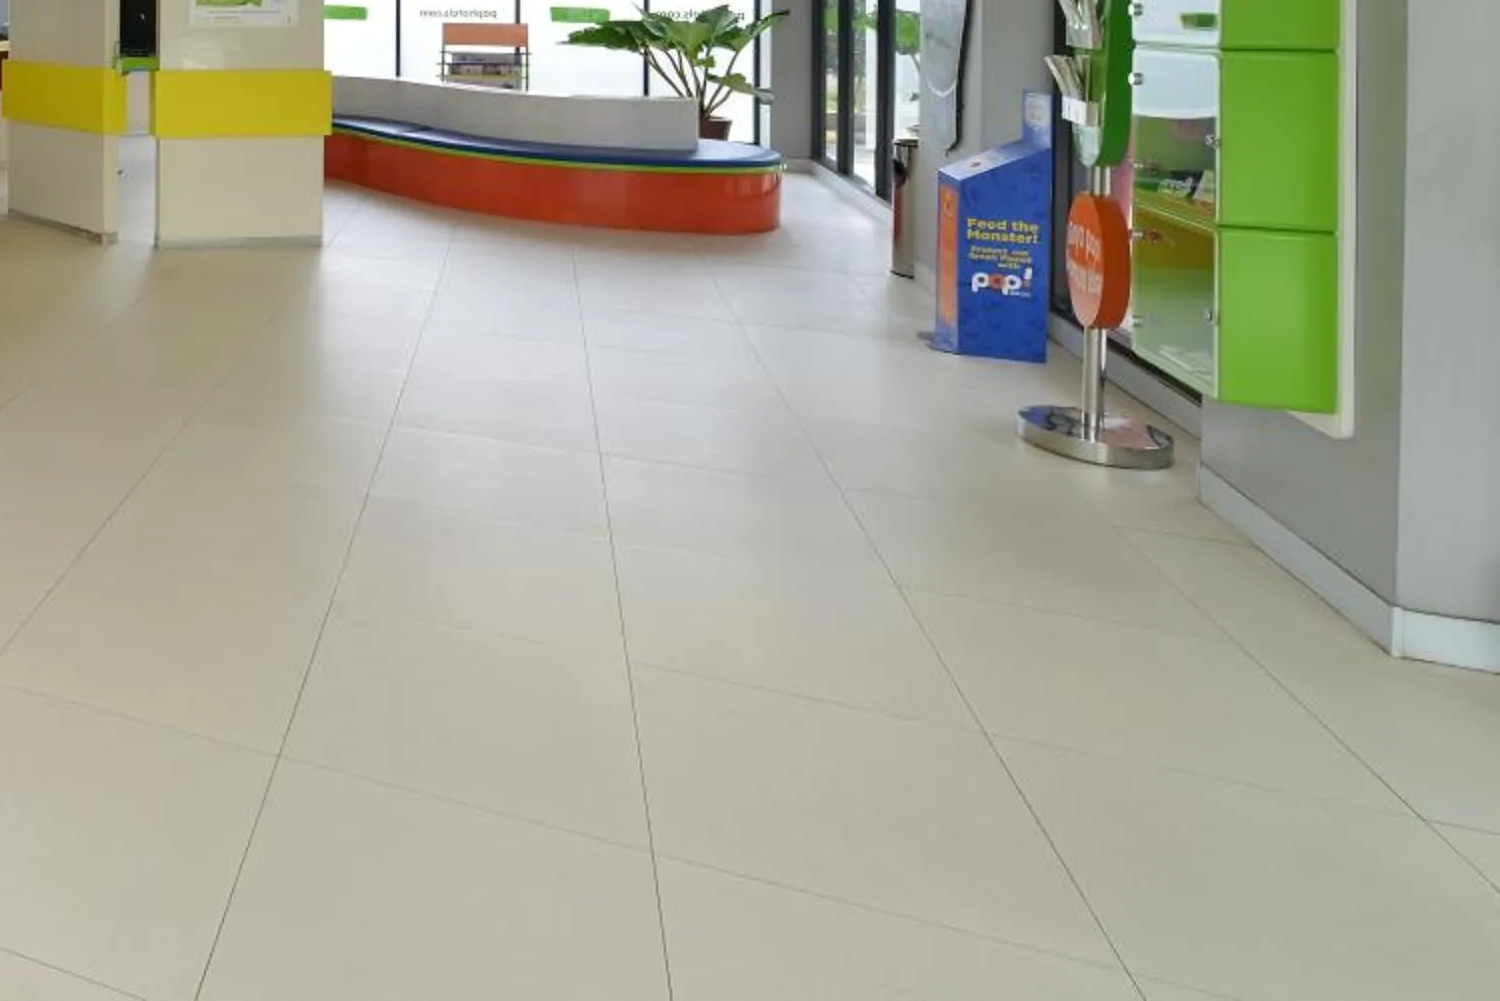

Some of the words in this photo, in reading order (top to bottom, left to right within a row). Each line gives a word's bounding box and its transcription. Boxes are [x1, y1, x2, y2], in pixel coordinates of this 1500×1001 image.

[967, 218, 1007, 230] Feed
[1012, 220, 1039, 234] the
[966, 229, 1038, 244] Monster!
[971, 267, 1033, 296] pop!
